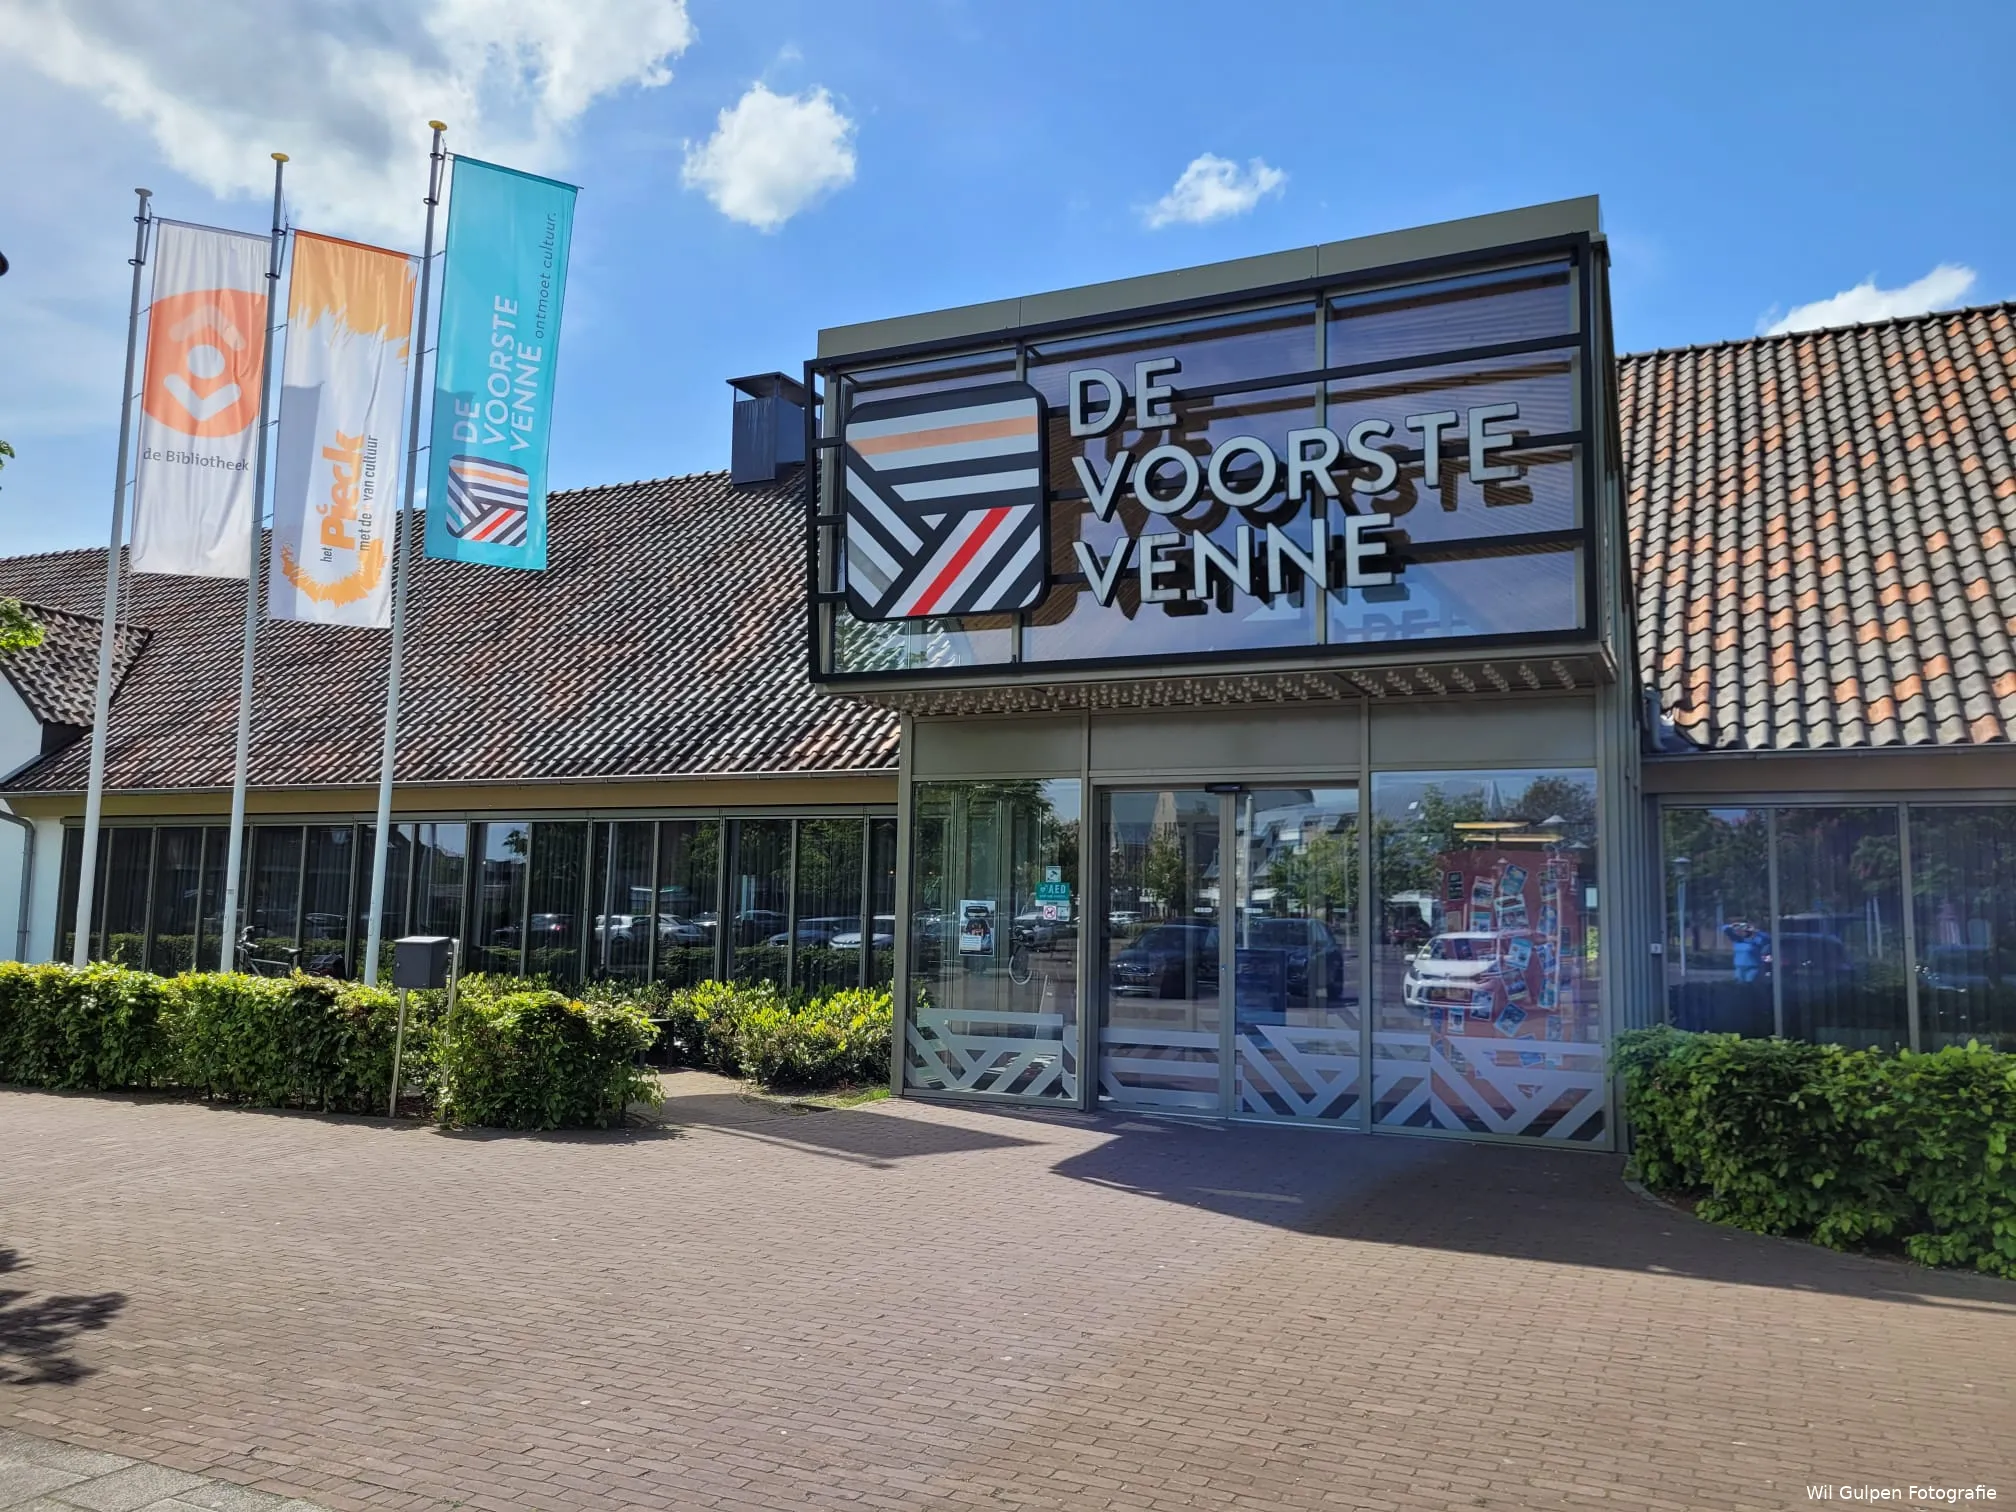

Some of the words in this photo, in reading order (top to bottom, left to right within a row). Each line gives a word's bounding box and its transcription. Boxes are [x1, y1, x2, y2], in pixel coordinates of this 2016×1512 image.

[538, 211, 557, 269] cultuur.
[535, 272, 551, 339] ontmoet
[482, 295, 518, 445] VOORSTE
[452, 399, 480, 444] DE
[509, 341, 542, 452] VENNE
[1068, 356, 1182, 438] DE
[143, 448, 162, 461] de
[165, 449, 250, 471] Bibliotheek
[362, 434, 378, 478] cultuur
[1071, 401, 1521, 523] VOORSTE
[316, 429, 365, 551] Pieck
[362, 482, 375, 502] van
[357, 527, 371, 551] met
[358, 512, 372, 528] de
[320, 547, 333, 563] het
[1071, 512, 1394, 608] VENNE
[1048, 884, 1066, 894] AED
